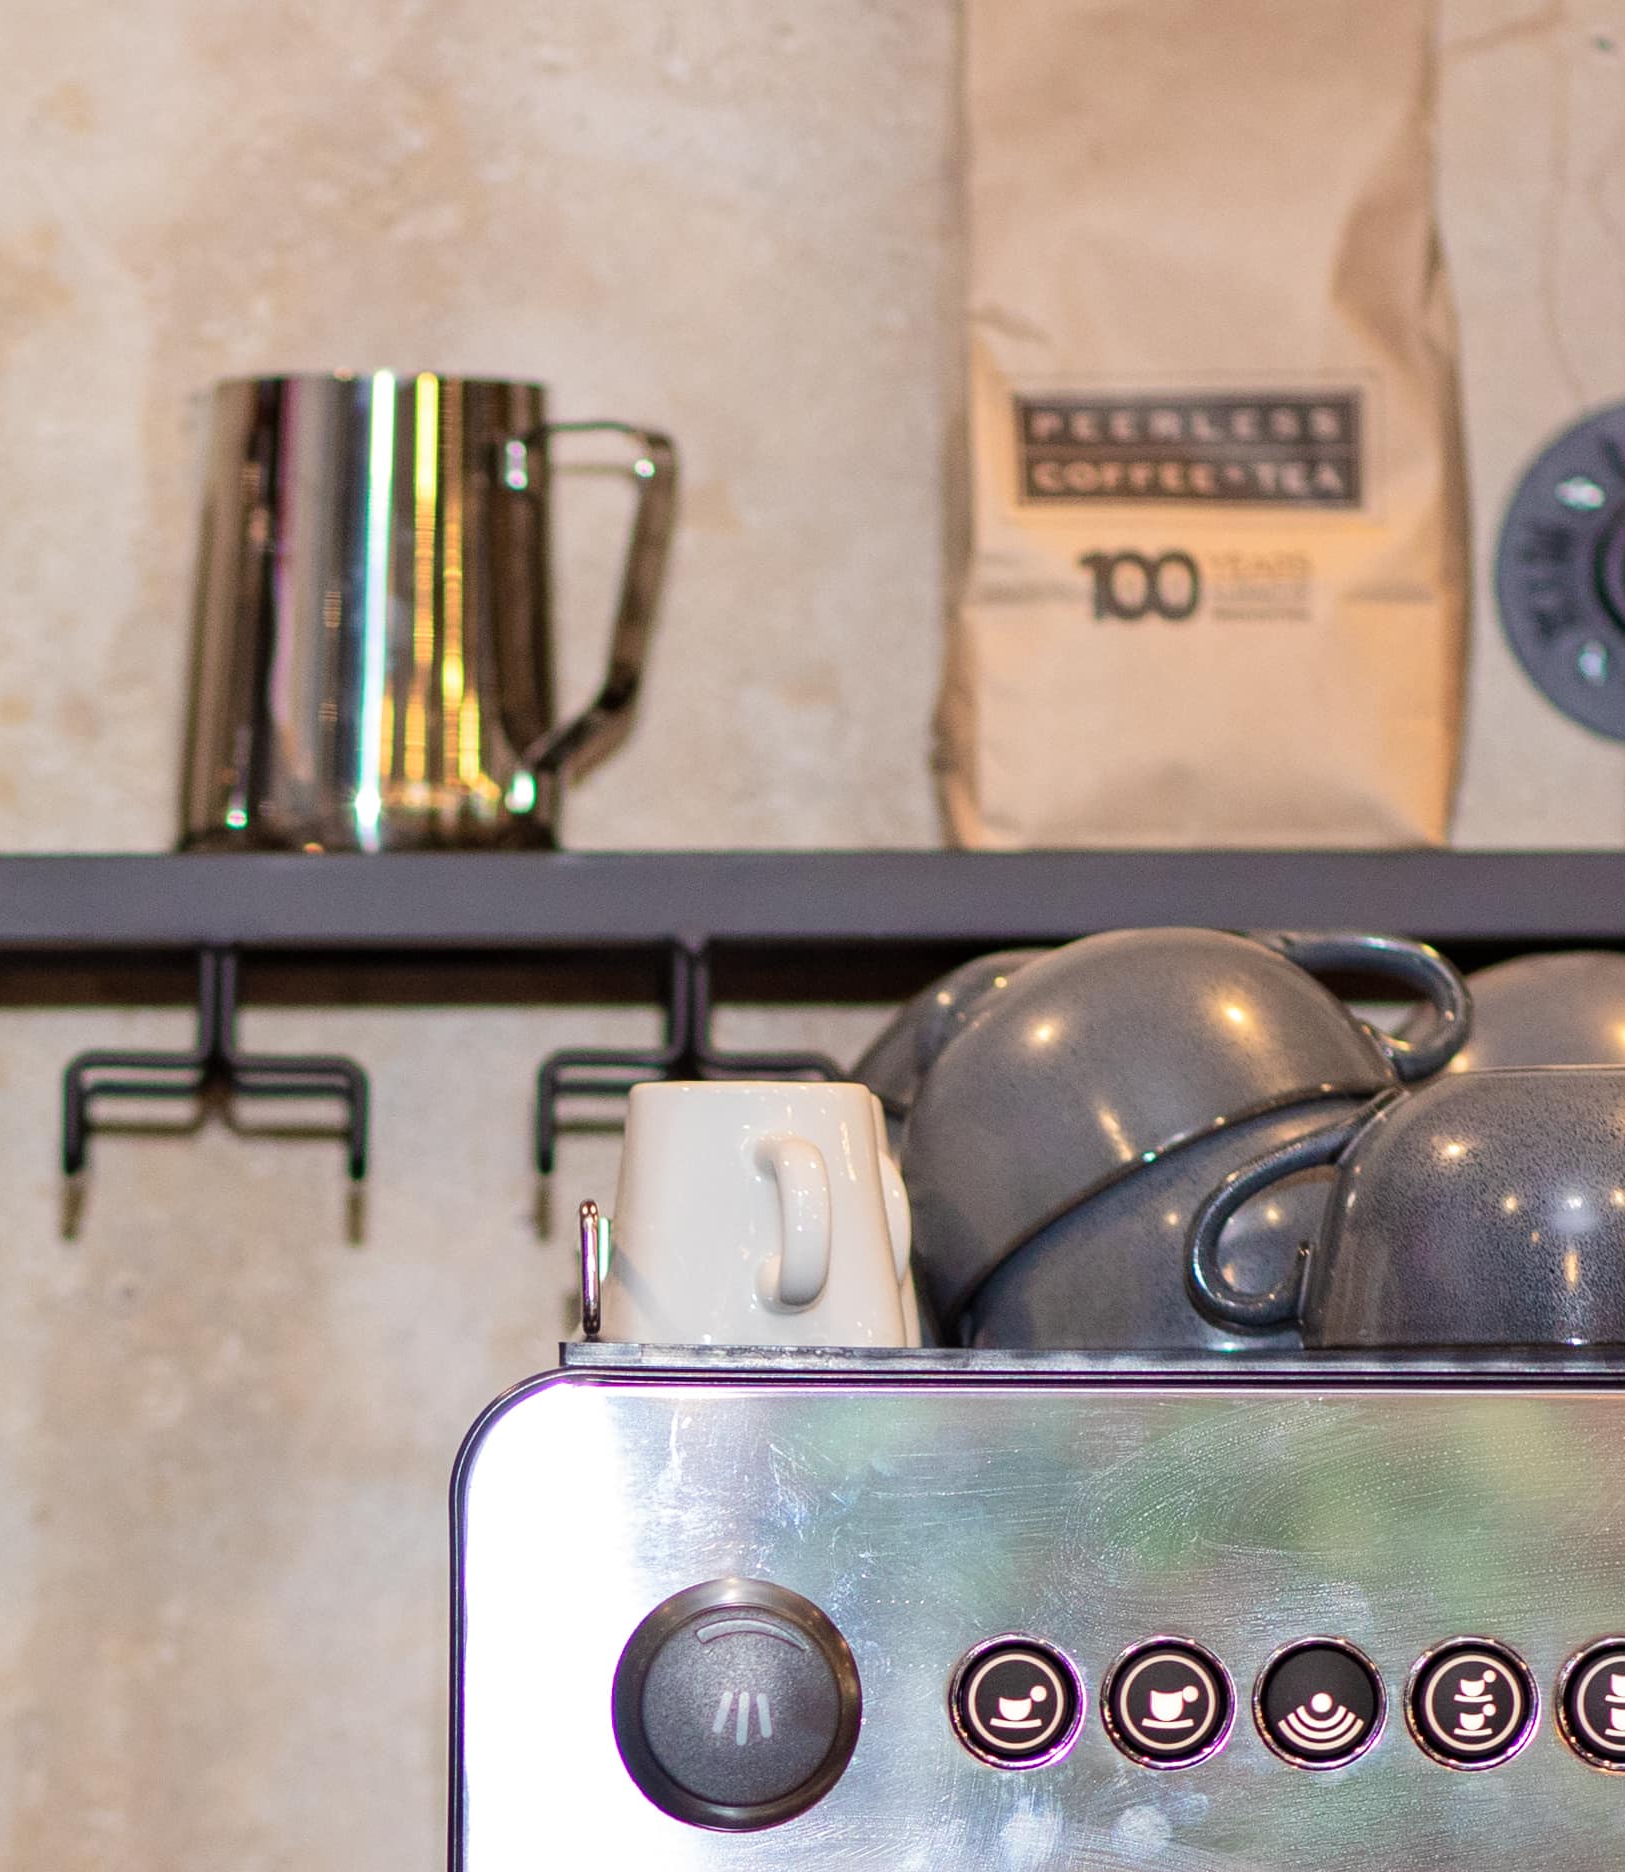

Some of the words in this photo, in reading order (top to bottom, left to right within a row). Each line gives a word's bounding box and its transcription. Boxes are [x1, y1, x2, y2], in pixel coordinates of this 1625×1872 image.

[1030, 460, 1216, 494] COFFEE
[1253, 460, 1344, 495] TEA
[1078, 549, 1199, 623] 100
